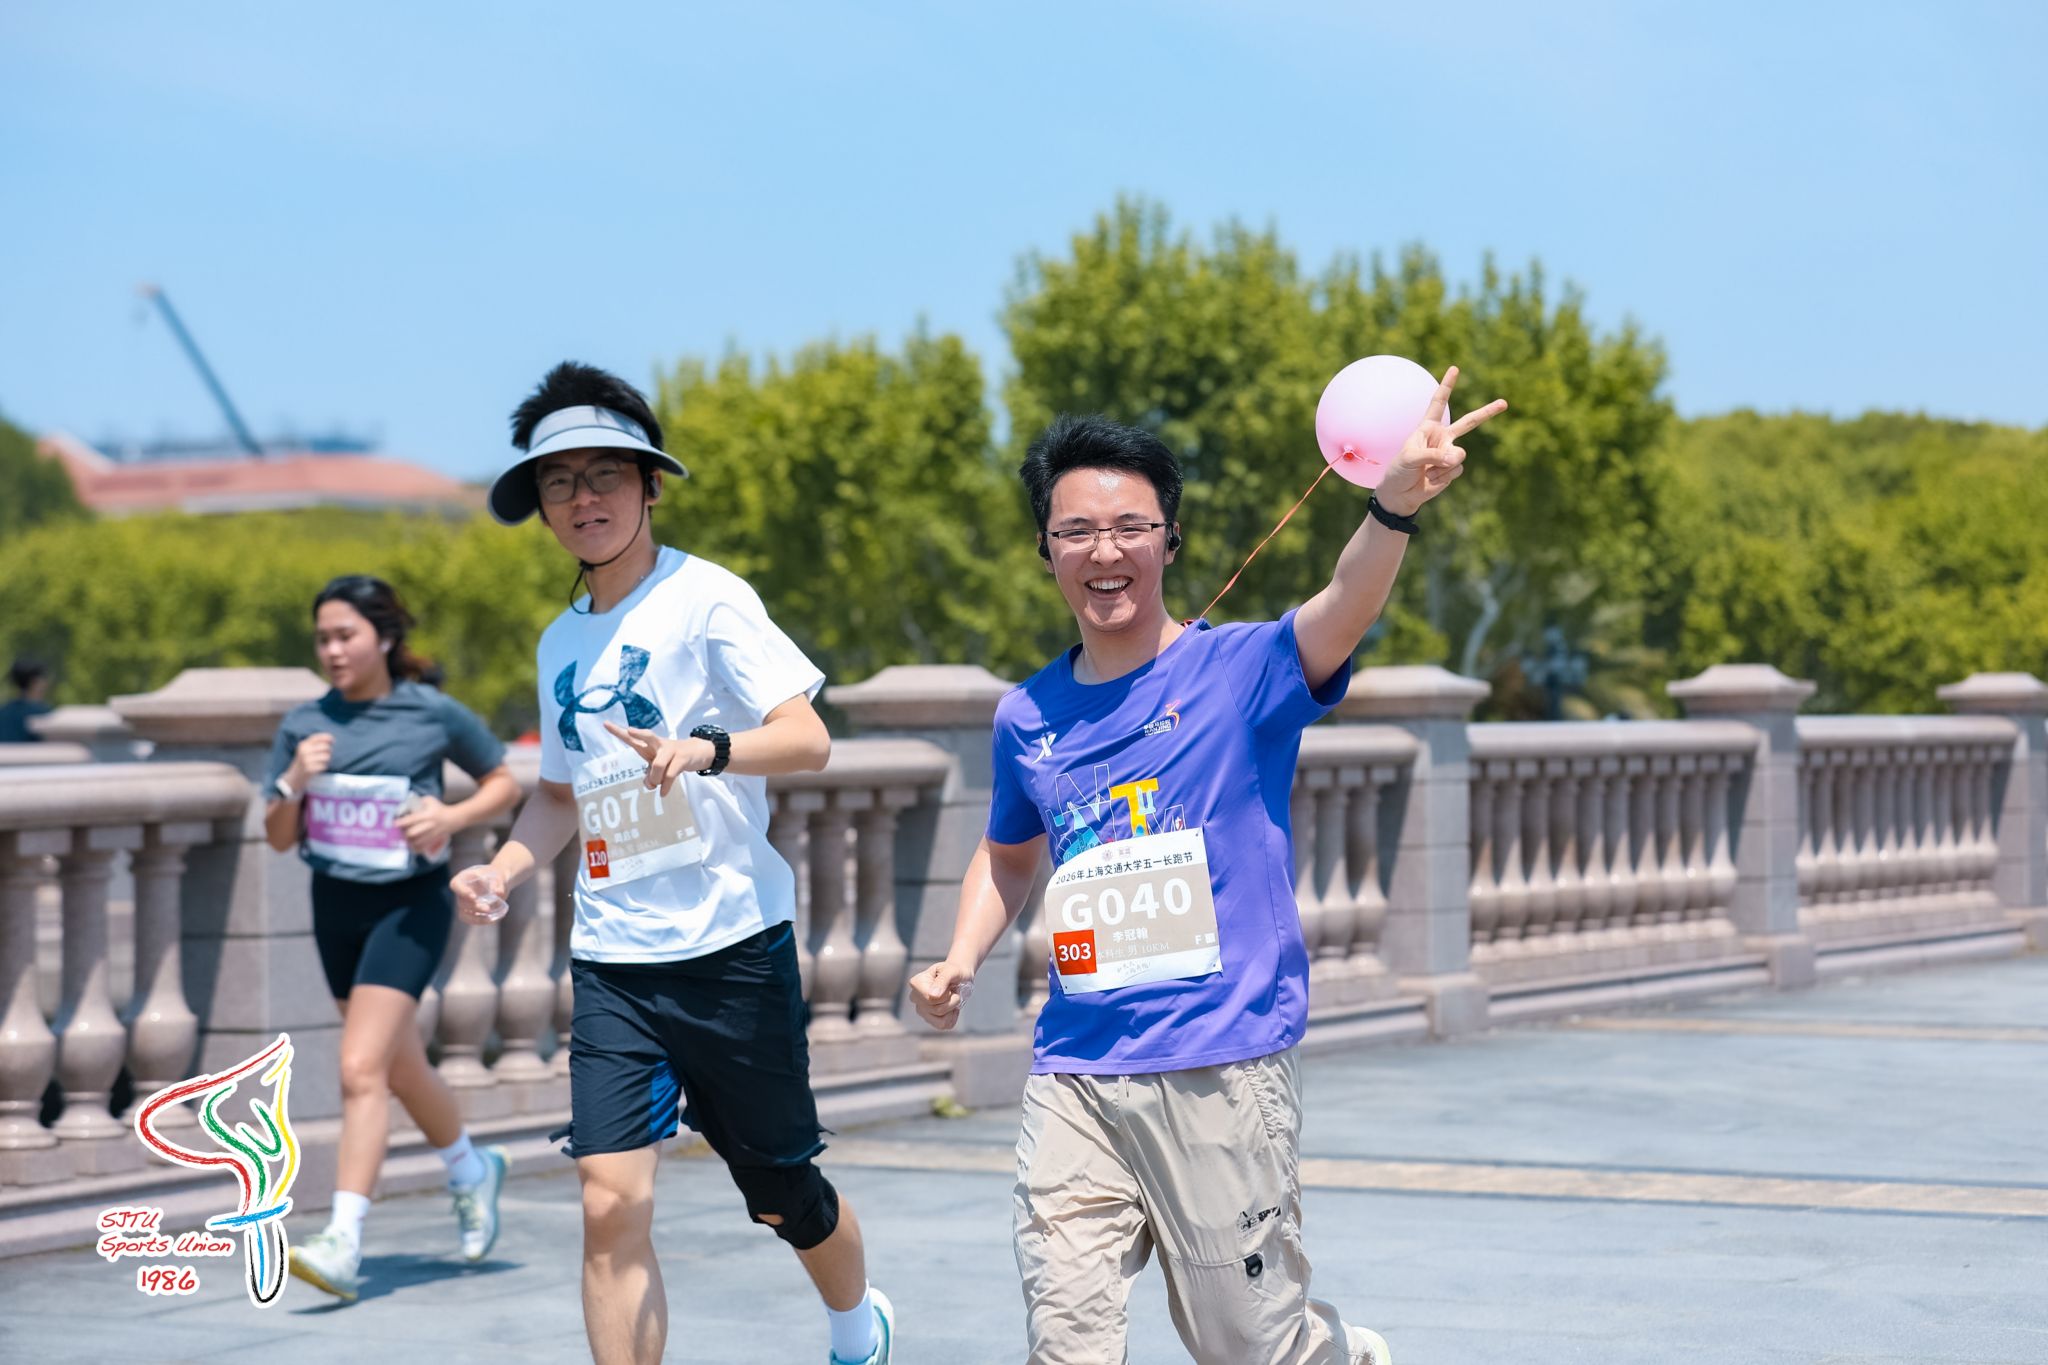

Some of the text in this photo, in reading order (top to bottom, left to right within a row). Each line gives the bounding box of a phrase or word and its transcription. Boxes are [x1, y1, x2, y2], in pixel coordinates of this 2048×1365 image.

[311, 799, 396, 829] M007
[583, 784, 664, 834] G077
[589, 851, 607, 867] 120
[1056, 851, 1194, 885] 2026年上海交通大学五一长跑节
[1061, 877, 1192, 930] G040
[1058, 943, 1092, 962] 303
